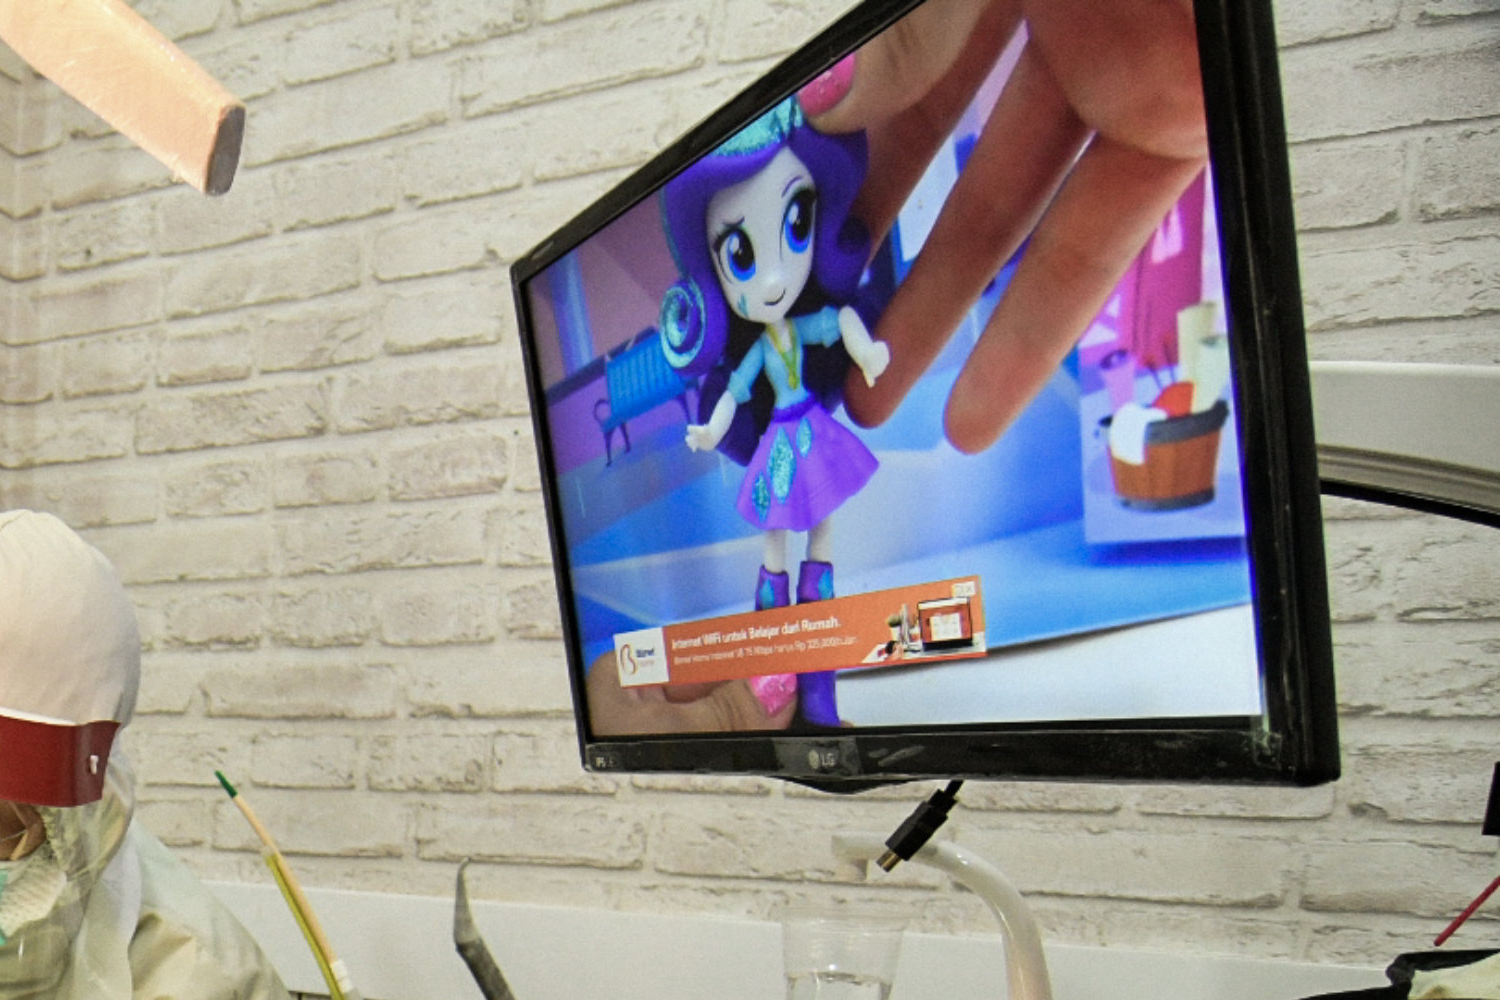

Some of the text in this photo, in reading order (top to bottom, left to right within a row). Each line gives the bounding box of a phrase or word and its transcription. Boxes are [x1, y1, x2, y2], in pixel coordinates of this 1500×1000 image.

[749, 625, 780, 640] Belajar
[781, 621, 800, 634] dari
[821, 753, 836, 767] LG
